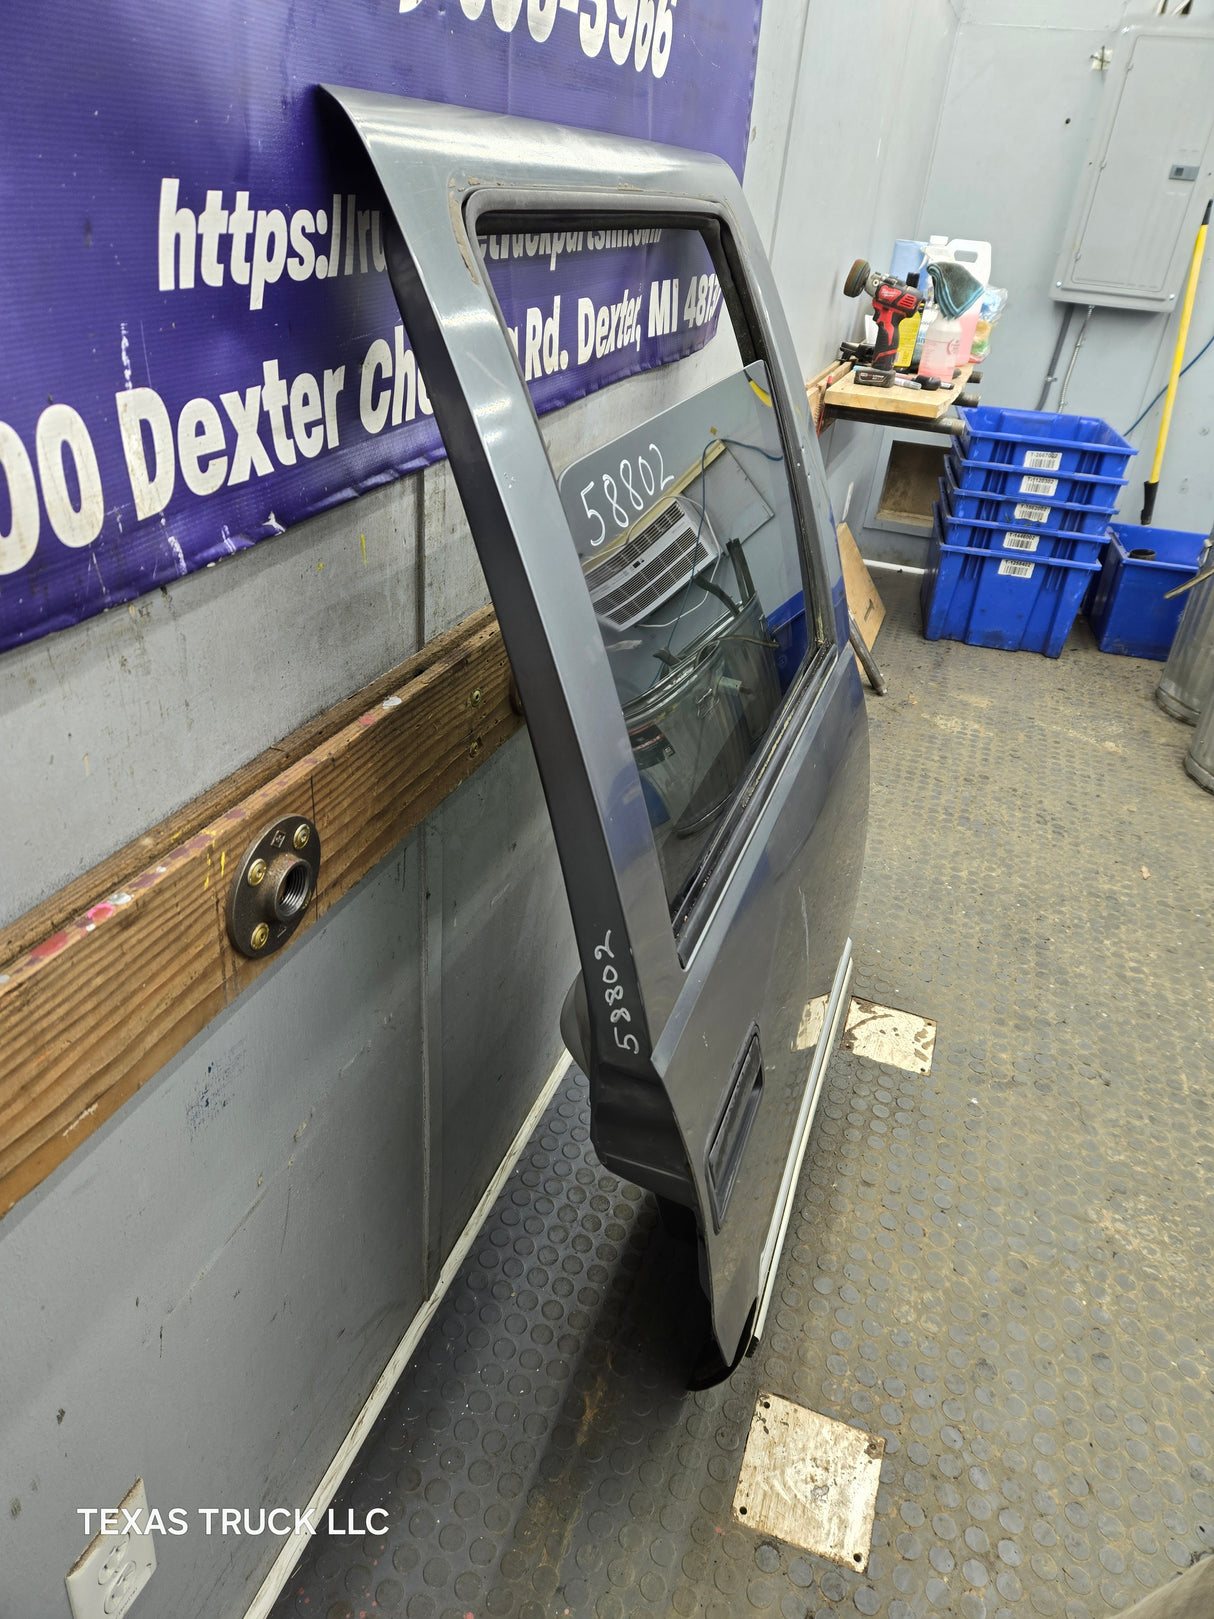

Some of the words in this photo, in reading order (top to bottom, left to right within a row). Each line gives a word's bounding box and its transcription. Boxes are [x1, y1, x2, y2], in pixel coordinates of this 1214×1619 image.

[115, 358, 345, 521] Dexter
[525, 294, 569, 382] Rd.
[577, 288, 643, 366] Dexter,
[647, 278, 680, 338] MI
[580, 443, 675, 547] 58802
[594, 929, 640, 1055] 58802
